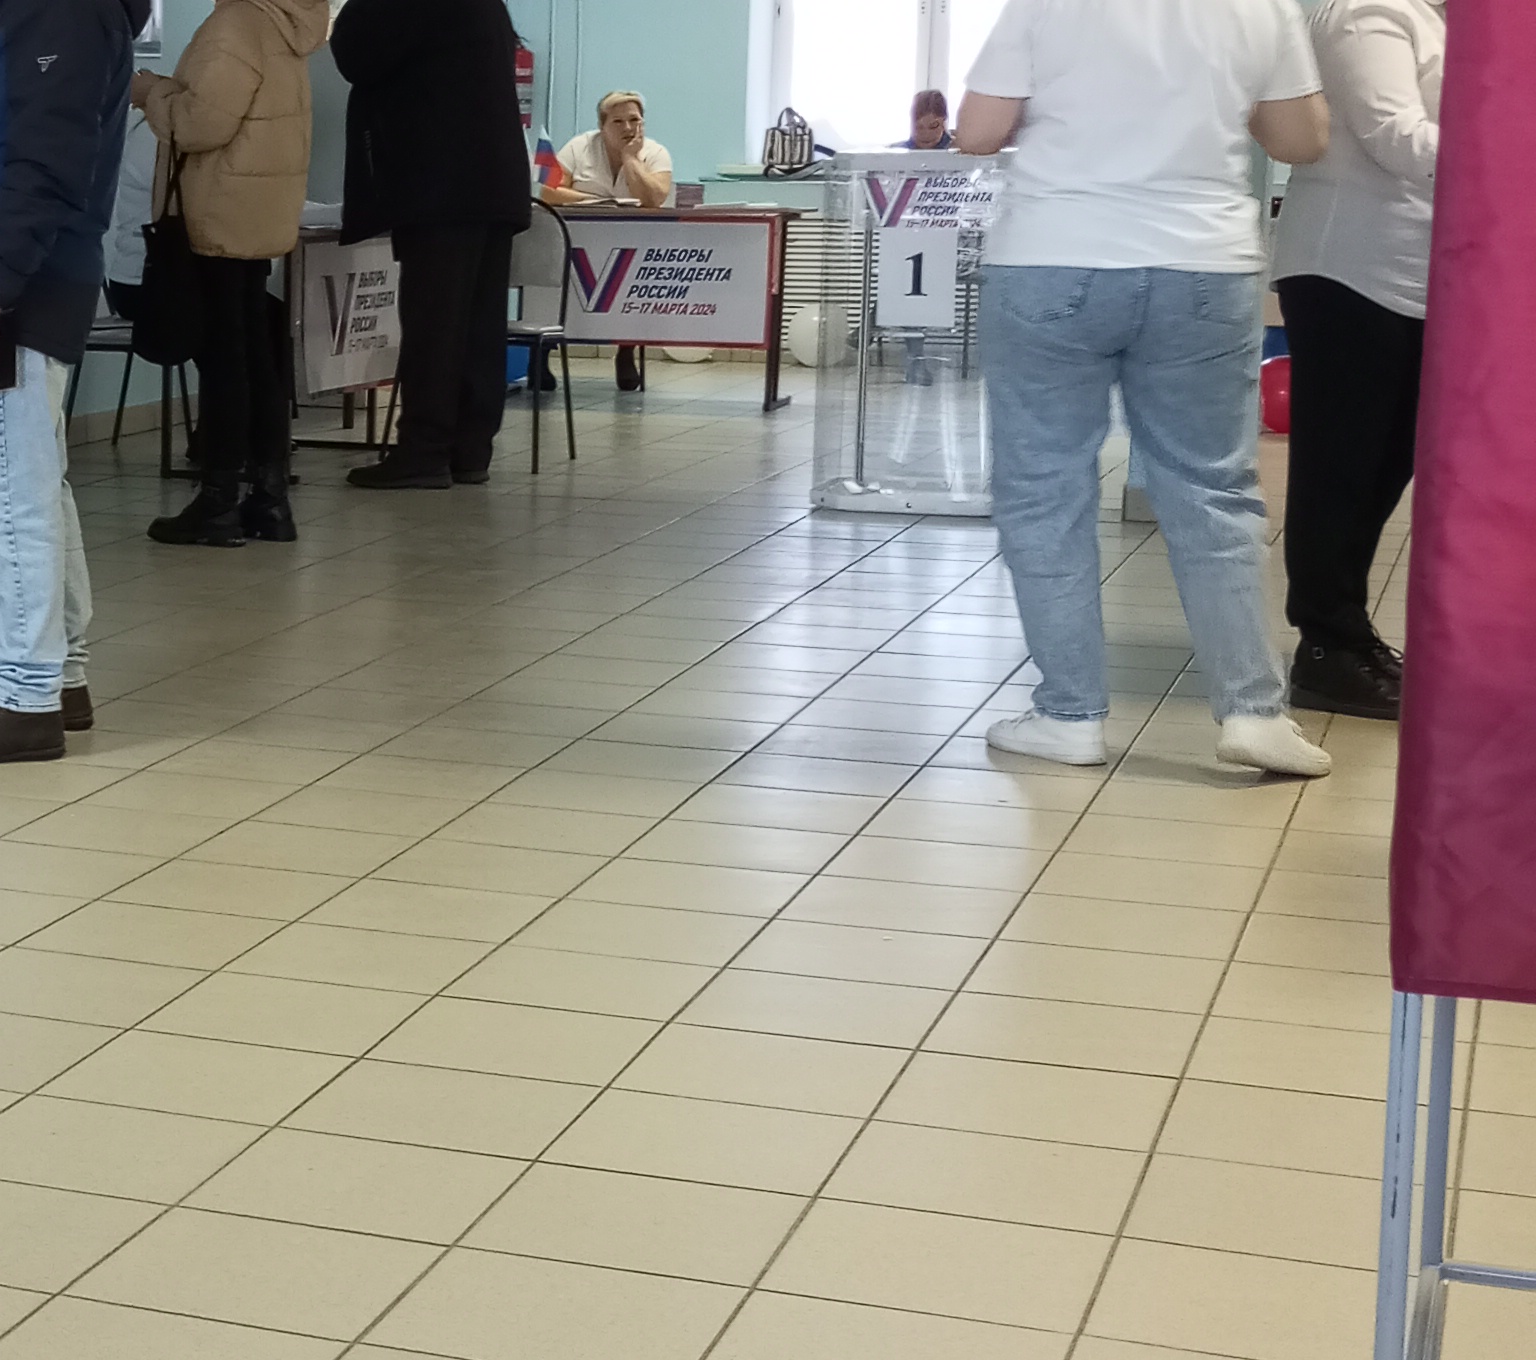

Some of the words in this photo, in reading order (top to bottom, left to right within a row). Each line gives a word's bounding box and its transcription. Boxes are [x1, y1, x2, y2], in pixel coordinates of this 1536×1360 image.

[917, 191, 993, 203] ПРЕЗИДЕНТА
[911, 205, 959, 216] РОССИИ
[643, 248, 713, 263] ВЫБОРЫ
[635, 266, 732, 283] ПРЕЗИДЕНТА
[904, 251, 928, 297] 1
[626, 284, 689, 299] РОССИИ
[653, 303, 688, 315] МАРТА
[689, 303, 716, 316] 2024
